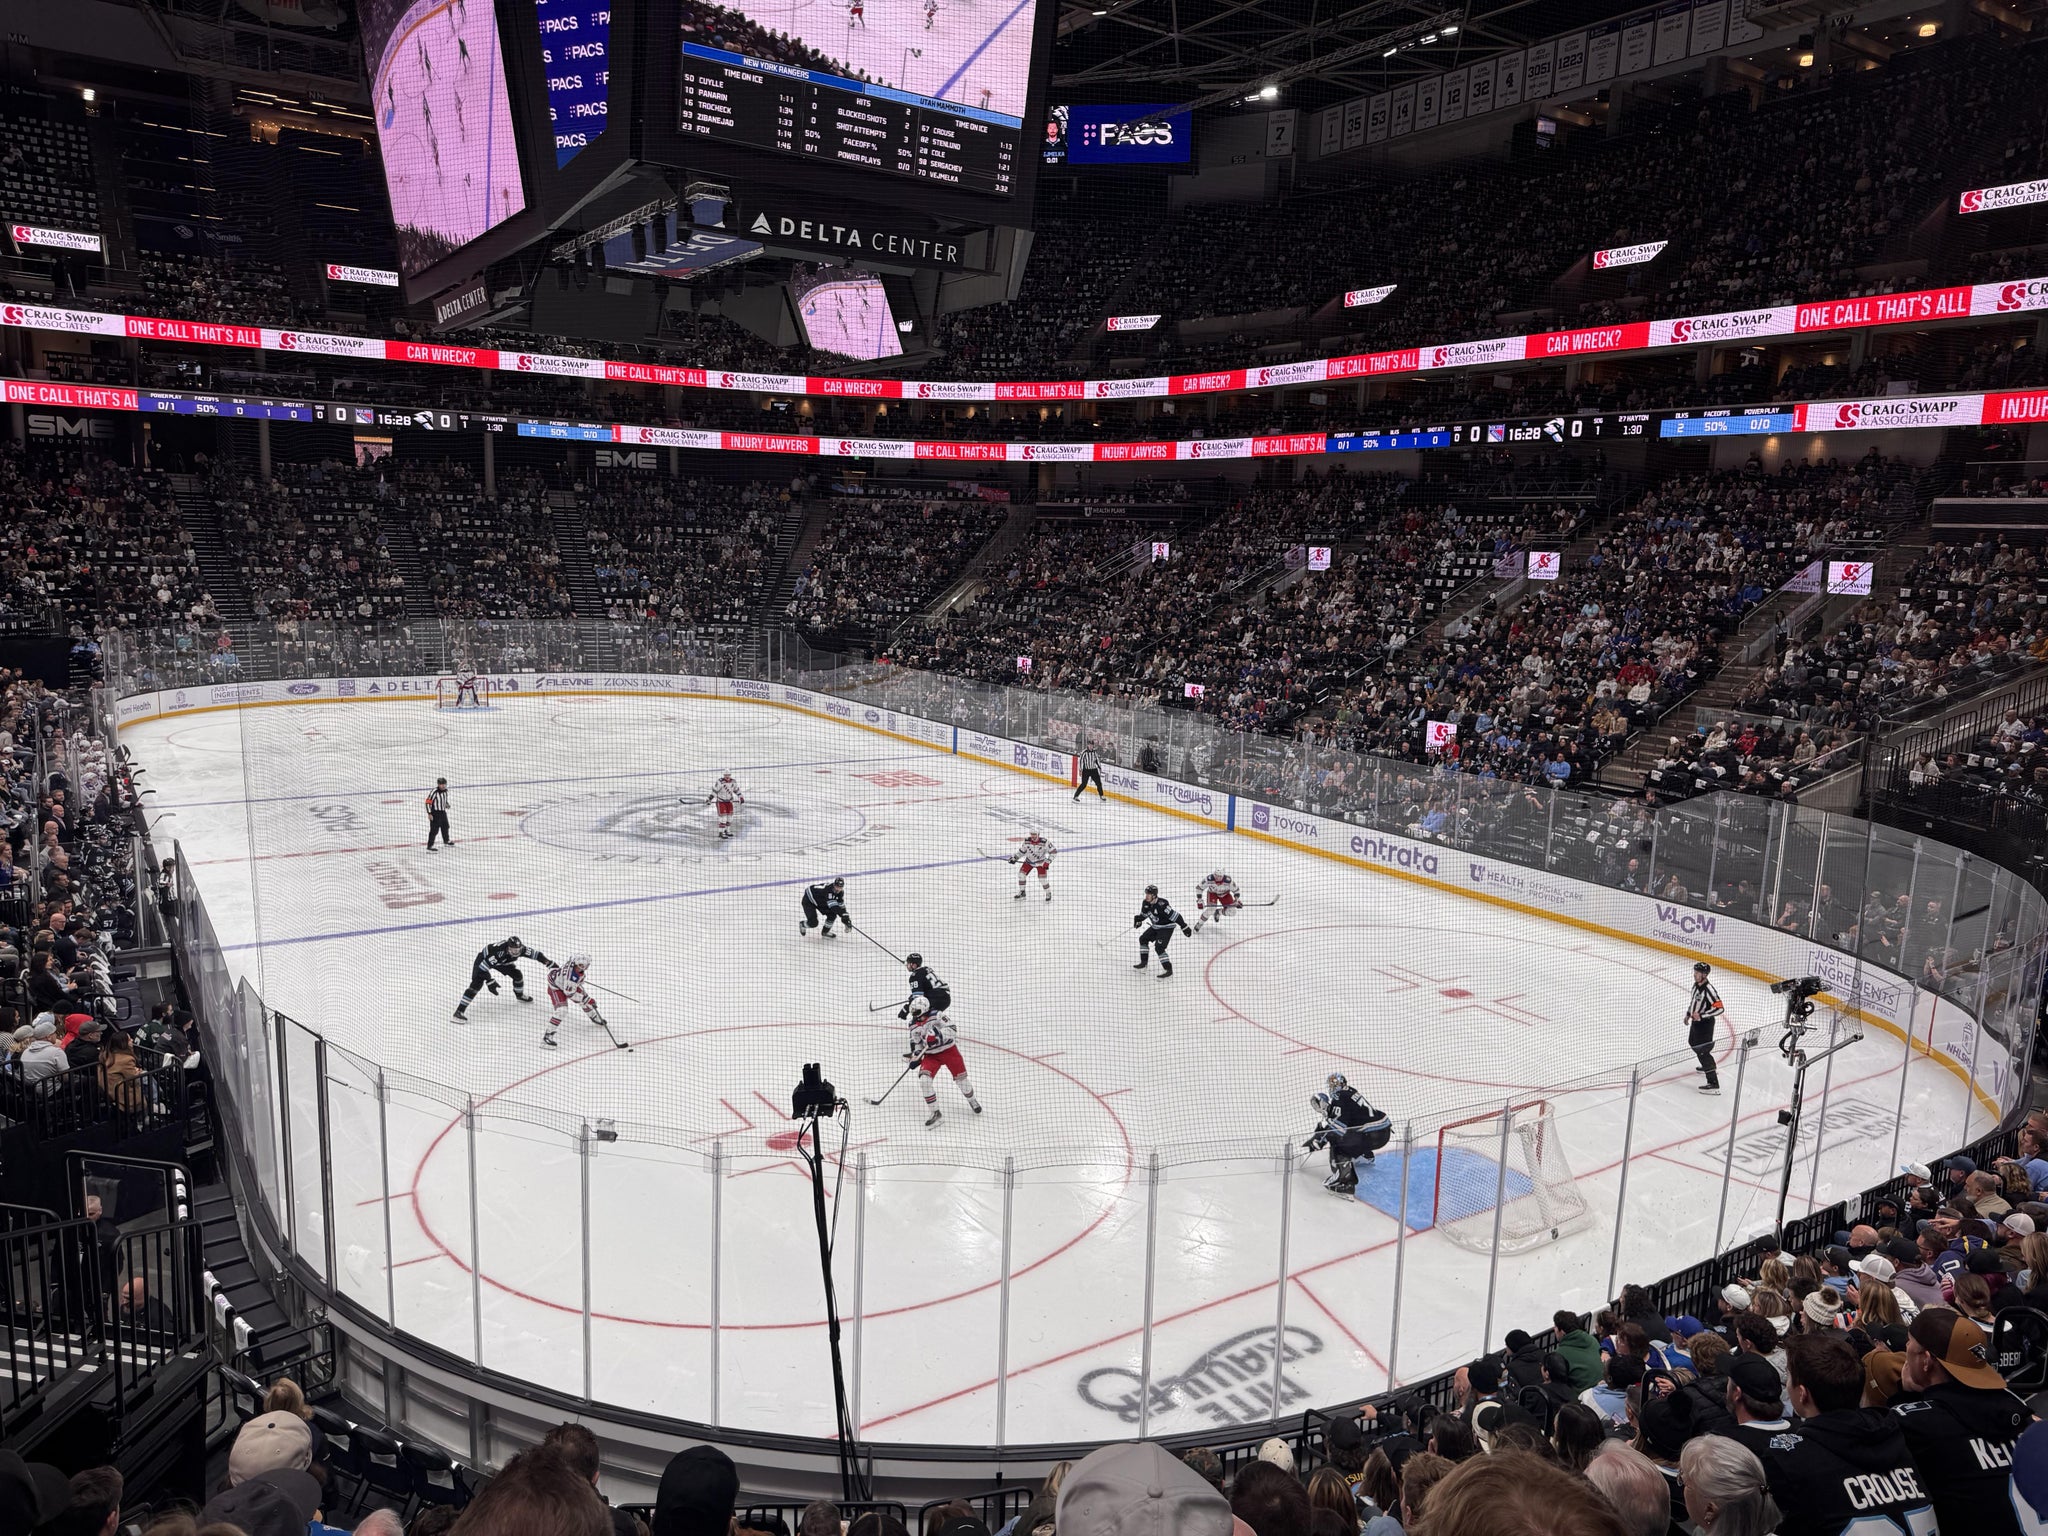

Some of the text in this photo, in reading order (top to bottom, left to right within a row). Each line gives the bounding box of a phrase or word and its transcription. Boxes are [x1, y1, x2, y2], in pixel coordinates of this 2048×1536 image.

[743, 58, 809, 79] NEW YORK RANGERS
[1558, 52, 1583, 70] 1223
[724, 68, 763, 84] TIME ON ICE
[1528, 62, 1551, 78] 3051
[699, 76, 724, 88] CUYLLE
[1505, 72, 1514, 88] 4
[684, 86, 728, 101] 10 PANARIN
[1447, 88, 1461, 105] 12
[1473, 80, 1490, 98] 32
[684, 98, 732, 114] 16 TROCHECK
[857, 98, 871, 107] HITS
[920, 98, 966, 115] UTAH MAMMOTH
[1424, 97, 1432, 112] 9
[779, 106, 793, 115] 1:34
[838, 108, 887, 125] BLOCKED SHOTS
[1371, 110, 1386, 126] 53
[1397, 103, 1409, 119] 14
[683, 110, 734, 127] 93 ZIBANEJAD
[778, 118, 792, 126] 1:33
[1348, 117, 1362, 133] 35
[682, 122, 710, 134] 23 FOX
[805, 129, 820, 139] 50%
[836, 122, 886, 139] SHOT ATTEMPTS
[933, 127, 955, 138] CROUSE
[955, 120, 988, 133] TIME ON ICE
[1276, 126, 1285, 141] 7
[777, 141, 791, 150] 1:46
[805, 144, 818, 152] 0/1
[843, 138, 870, 149] FACEOFF
[932, 139, 961, 150] STENLUND
[838, 151, 881, 166] POWER PLAYS
[897, 149, 912, 157] 50%
[931, 149, 945, 158] COLE
[898, 162, 910, 171] 0/0
[930, 160, 962, 172] SERGACHEV
[930, 171, 959, 183] VEJMELKA
[1984, 186, 2024, 200] CRAIG
[1992, 193, 2046, 207] ASSOCIATES
[32, 229, 99, 244] CRAIG SWAPP
[780, 217, 957, 263] DELTA CENTER
[442, 287, 487, 320] DELTA CENTER
[1800, 292, 1967, 328] ONE CALL THAT'S ALL
[24, 308, 103, 324] CRAIG SWAPP
[1692, 313, 1772, 331] CRAIG SWAPP
[34, 319, 90, 331] ASSOCIATES
[129, 320, 259, 345] ONE CALL THAT'S ALL
[1692, 326, 1756, 340] & ASSOCIATES
[1547, 329, 1622, 353] CAR WRECK?
[407, 346, 476, 365] CAR WRECK?
[1328, 352, 1418, 376] ONE CALL THAT'S ALL
[9, 385, 35, 401] ONE
[40, 387, 73, 403] CALL
[76, 389, 120, 406] THAT'S
[1862, 401, 1958, 416] CRAIG SWAPP
[28, 414, 115, 438] SME
[378, 414, 411, 426] 16:28
[1704, 421, 1728, 432] 50%
[1861, 414, 1939, 426] & ASSOCIATES
[1508, 427, 1541, 441] 16:28
[1571, 420, 1582, 438] 0
[1623, 425, 1642, 435] 1:30
[730, 436, 808, 451] INJURY LAWYERS
[293, 684, 314, 694] Ford
[546, 678, 594, 687] FILEVINE
[603, 677, 672, 688] ZIONS BANK
[730, 680, 770, 691] AMERICAN
[214, 689, 261, 699] INGREDIENTS
[736, 689, 770, 699] EXPRESS
[826, 702, 850, 717] verizon
[1273, 815, 1318, 838] TOYOTA
[1350, 835, 1438, 876] entrata
[1487, 870, 1524, 889] HEALTH
[1652, 929, 1714, 951] CYBERSECURITY
[1814, 950, 1842, 966] JUST
[1813, 963, 1895, 1006] INGREDIENTS
[1843, 1467, 1926, 1510] CROUSE
